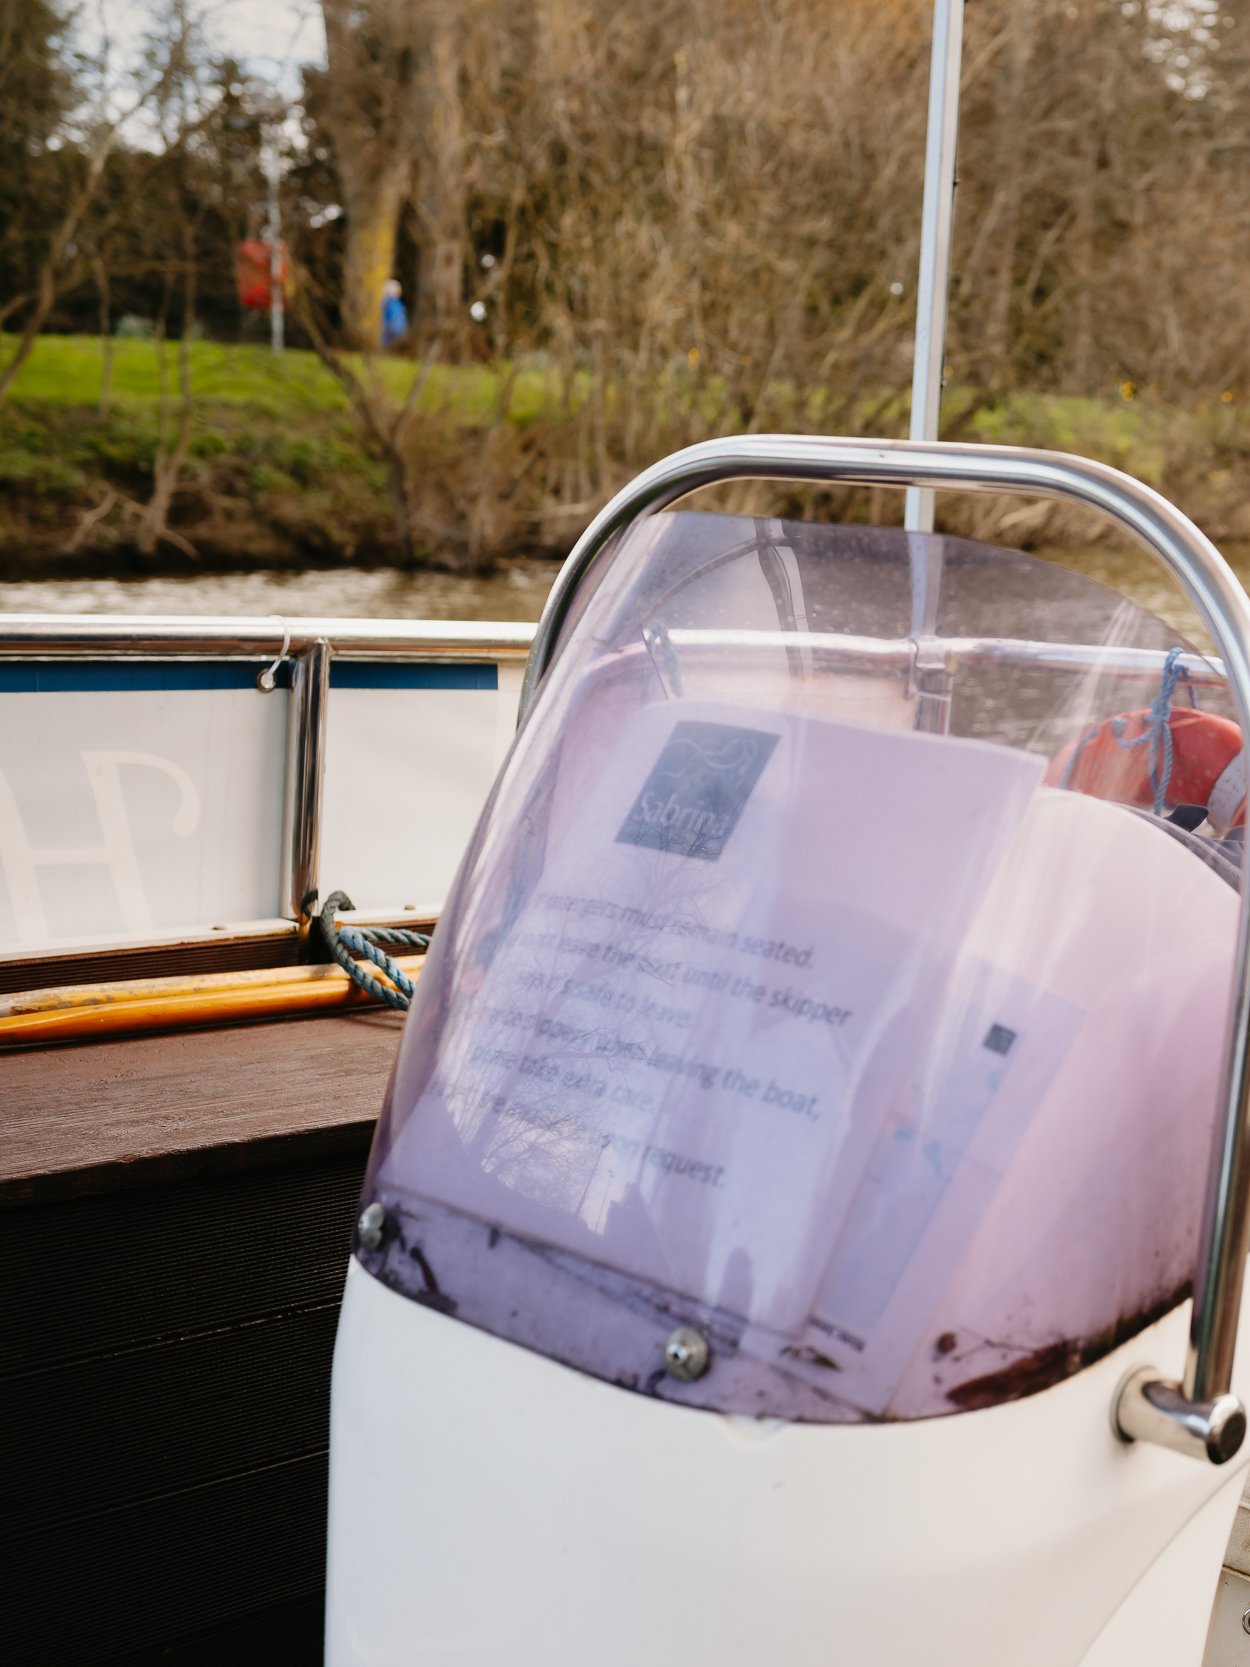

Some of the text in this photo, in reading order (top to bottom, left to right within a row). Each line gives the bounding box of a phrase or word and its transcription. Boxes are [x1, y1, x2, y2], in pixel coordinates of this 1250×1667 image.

[634, 791, 731, 837] Sabrina
[739, 937, 814, 969] seated.
[682, 966, 732, 993] until
[730, 975, 767, 1003] the
[768, 987, 853, 1026] skipper
[648, 1046, 720, 1091] leaving
[722, 1069, 760, 1097] the
[763, 1079, 821, 1122] boat,
[645, 1147, 727, 1189] request.
